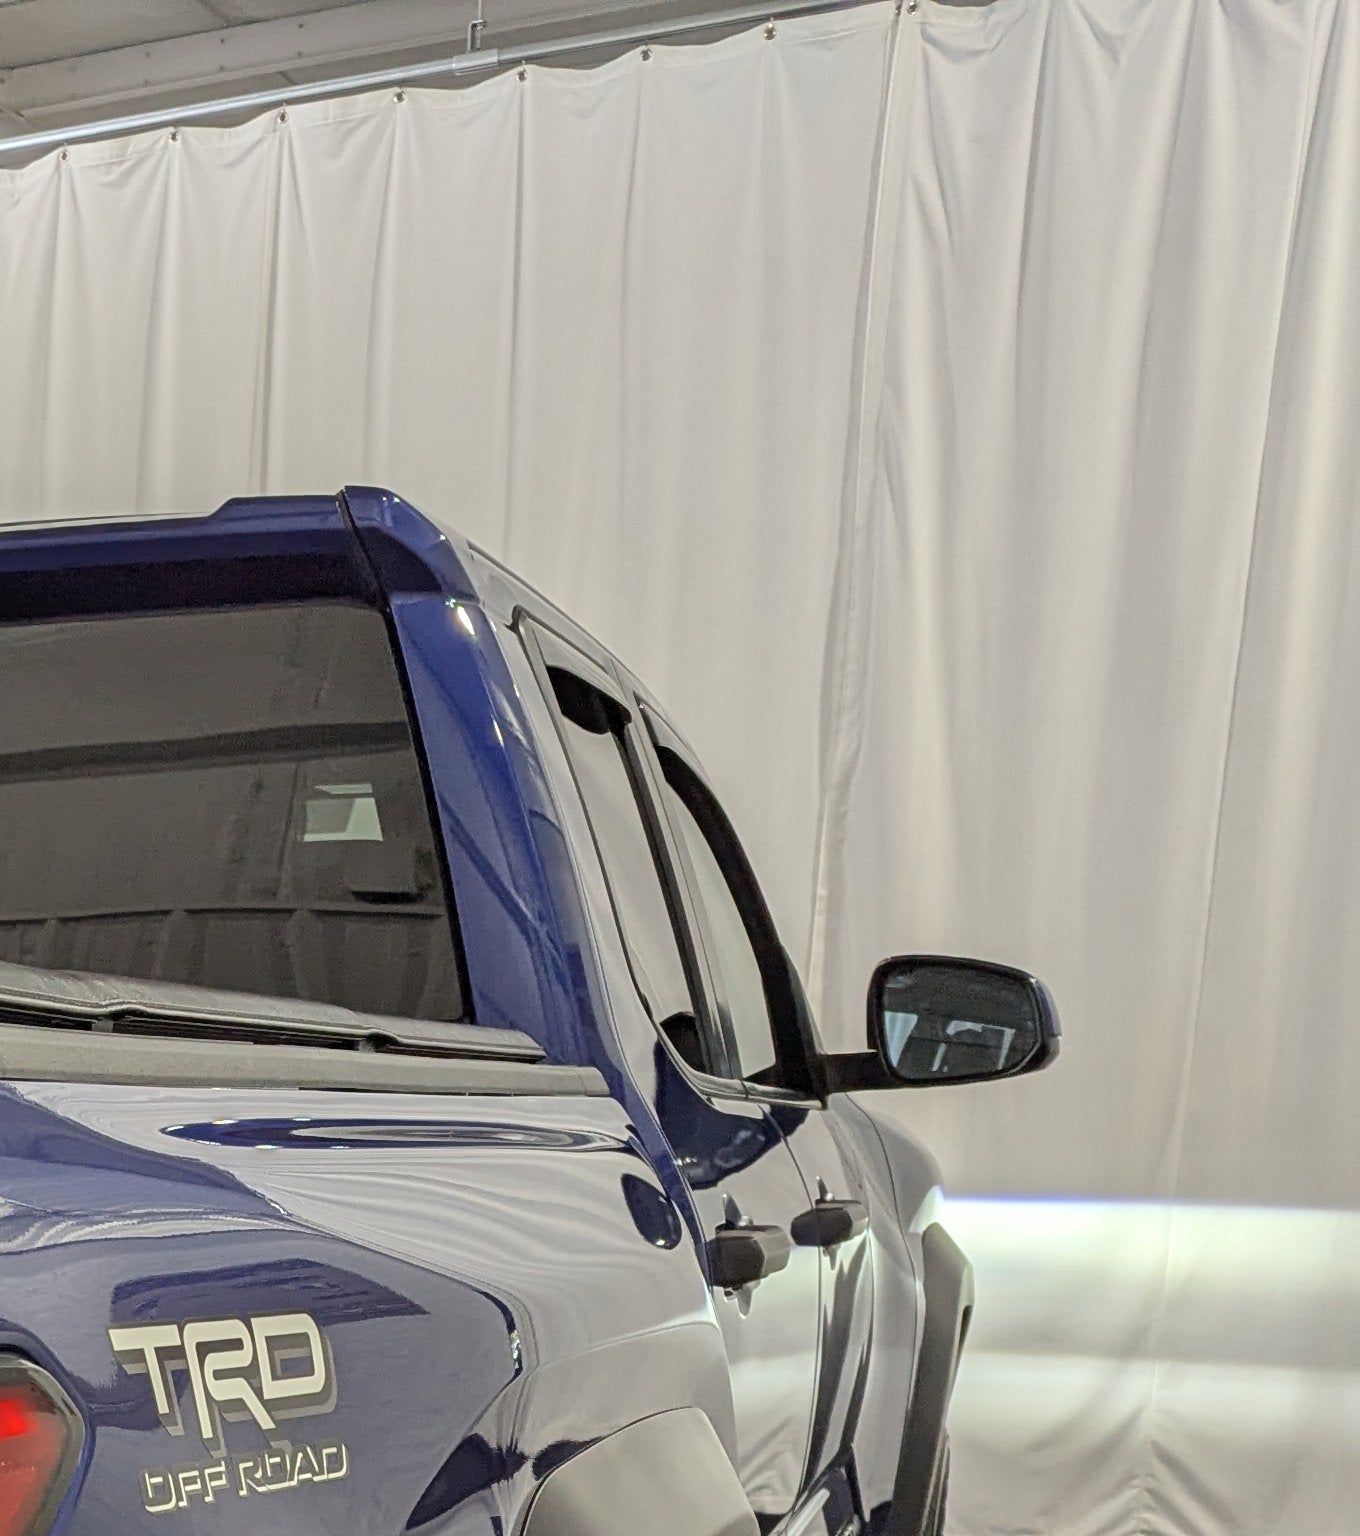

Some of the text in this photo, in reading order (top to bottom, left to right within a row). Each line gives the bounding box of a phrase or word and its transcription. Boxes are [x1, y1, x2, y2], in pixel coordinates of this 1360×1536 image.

[107, 1311, 334, 1448] TRD
[142, 1442, 349, 1514] OFF ROAD
